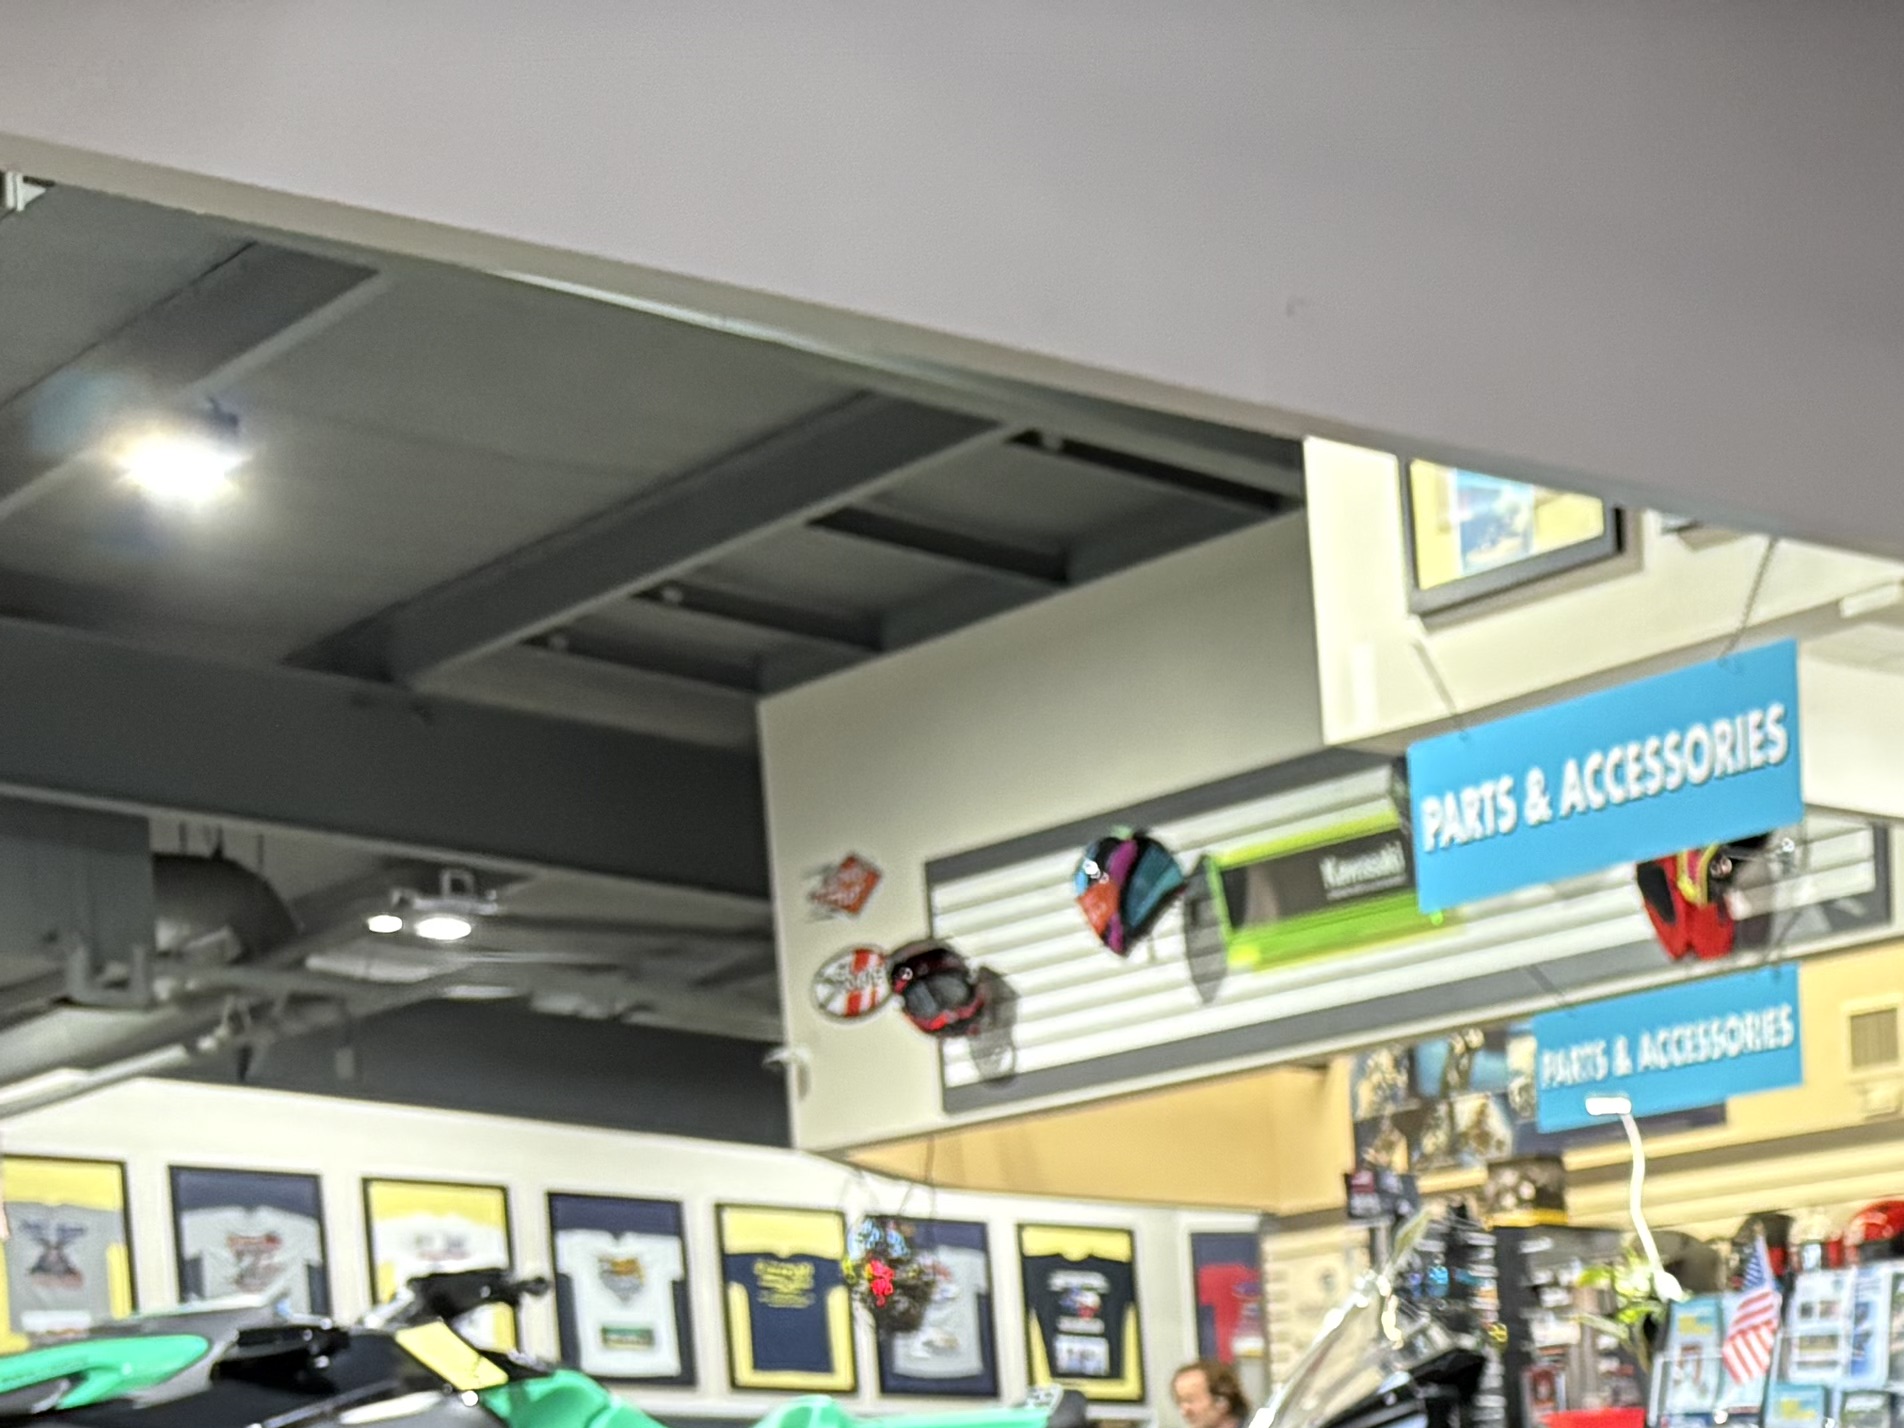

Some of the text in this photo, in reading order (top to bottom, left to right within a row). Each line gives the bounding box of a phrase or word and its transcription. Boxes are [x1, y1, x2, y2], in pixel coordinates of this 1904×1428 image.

[1421, 702, 1789, 852] PARTS & ACCESSORIES
[1541, 1002, 1795, 1089] PARTS & ACCESSORIES
